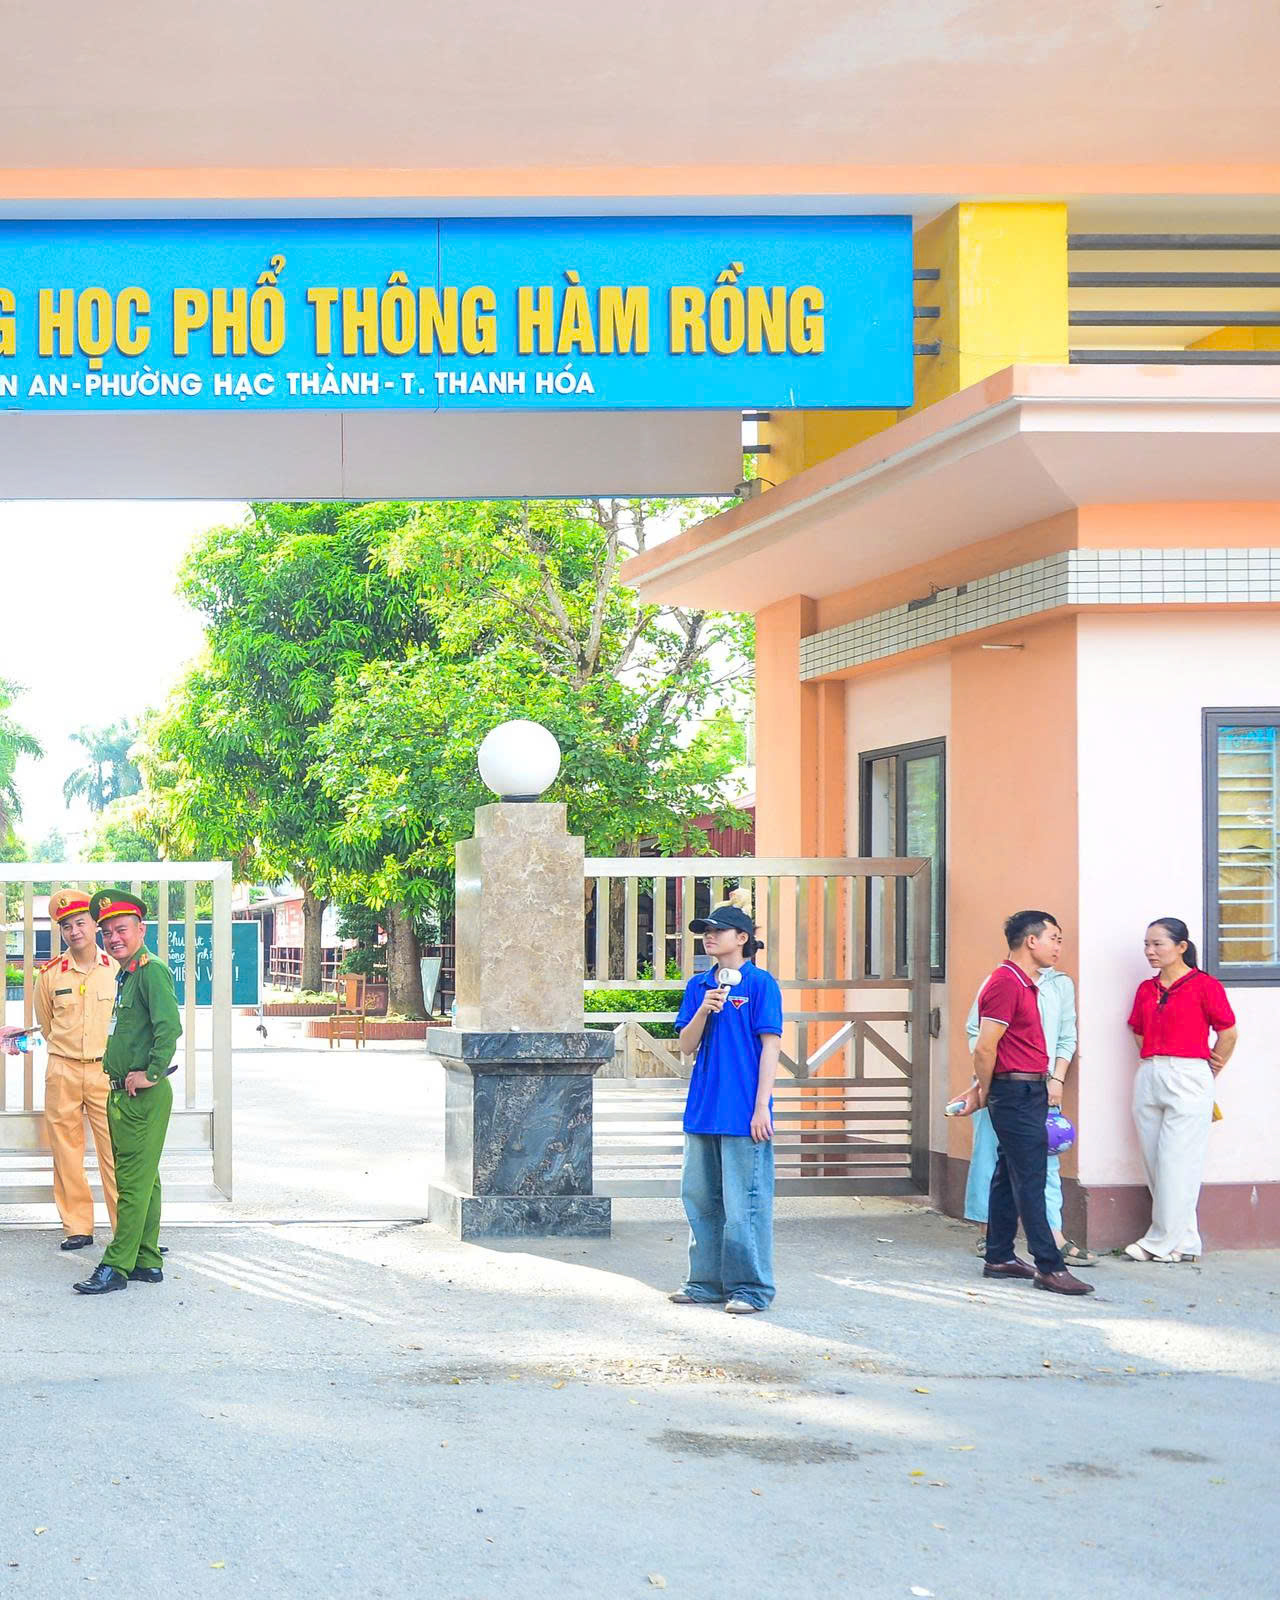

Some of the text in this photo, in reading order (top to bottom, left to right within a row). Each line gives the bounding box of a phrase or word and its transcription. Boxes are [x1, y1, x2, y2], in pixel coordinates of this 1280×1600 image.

[39, 287, 150, 370] HỌC
[173, 254, 286, 356] PHỔ
[308, 271, 498, 356] THÔNG
[518, 270, 650, 355] HÀM
[670, 261, 825, 355] RỒNG
[214, 373, 275, 401] HẠC
[434, 371, 526, 395] THANH
[535, 362, 595, 395] HÓA
